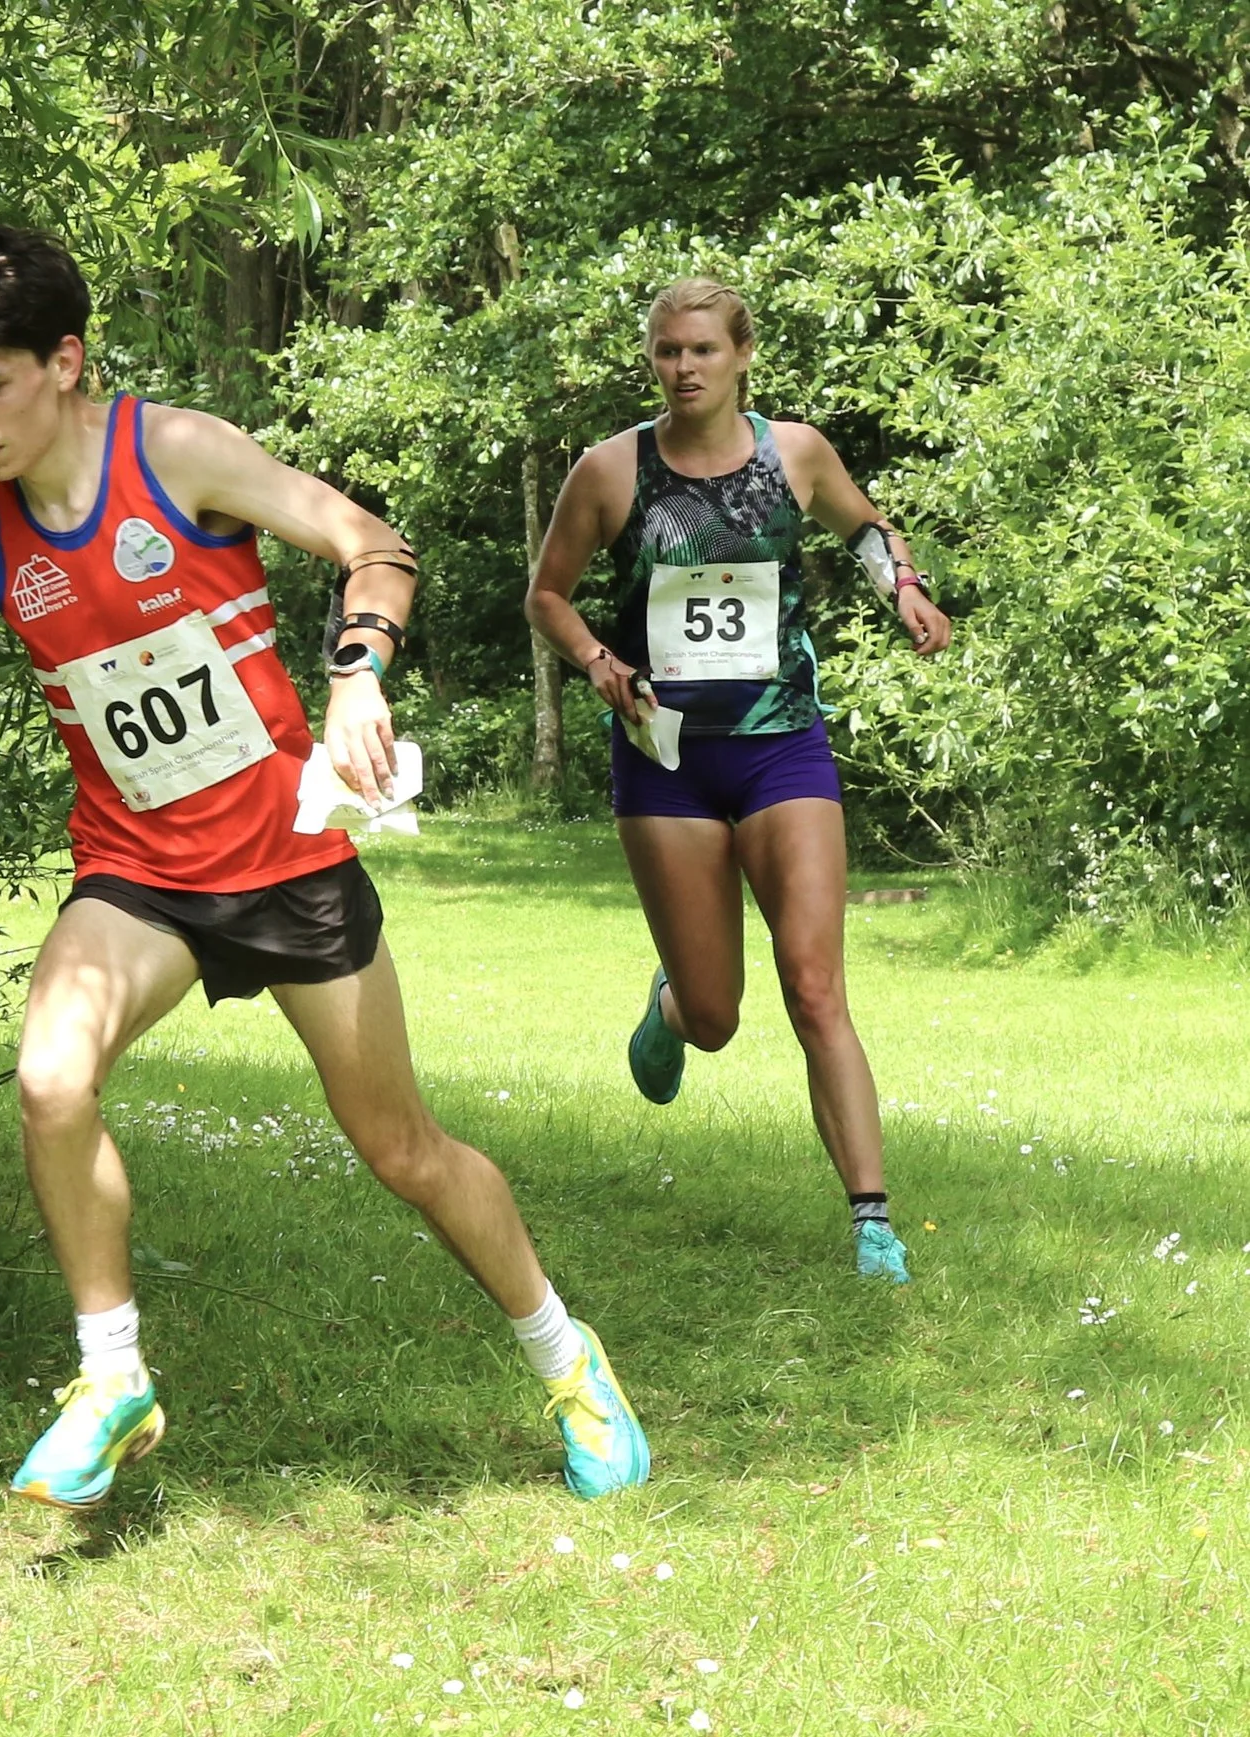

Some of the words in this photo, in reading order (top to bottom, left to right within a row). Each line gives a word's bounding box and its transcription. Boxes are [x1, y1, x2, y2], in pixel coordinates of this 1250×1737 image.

[137, 587, 182, 613] kalas
[683, 597, 746, 643] 53
[688, 651, 709, 659] Sprint
[710, 650, 762, 659] Championships
[105, 664, 221, 759] 607
[150, 760, 174, 776] Sprint
[175, 729, 240, 764] Championships
